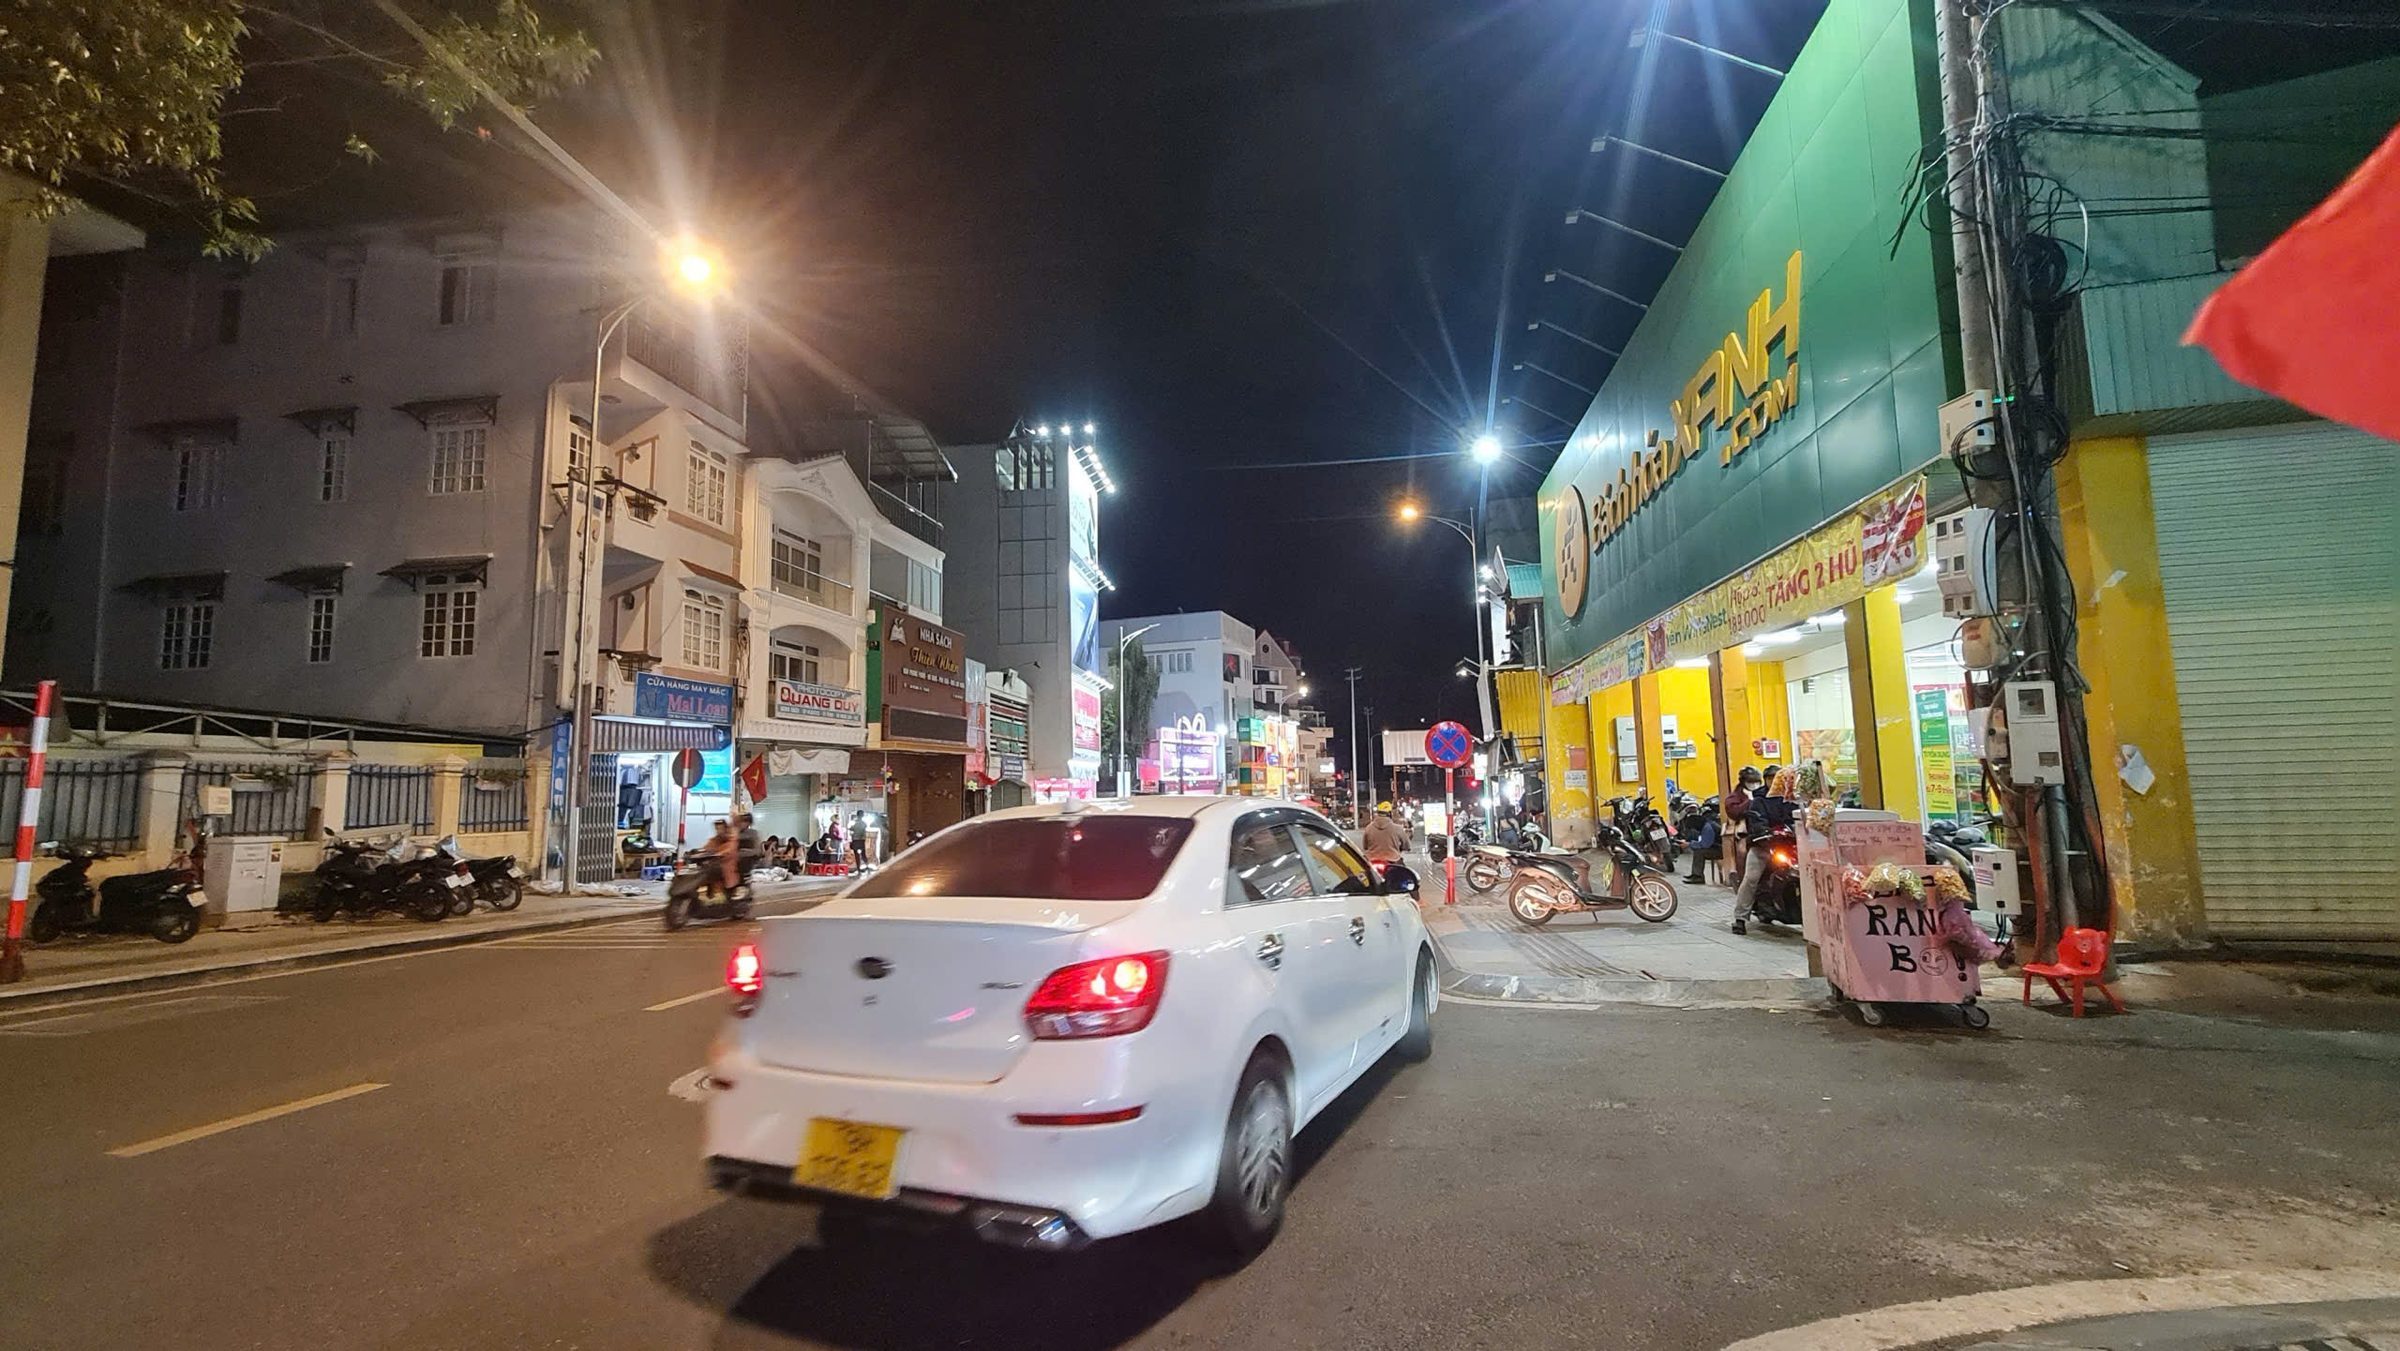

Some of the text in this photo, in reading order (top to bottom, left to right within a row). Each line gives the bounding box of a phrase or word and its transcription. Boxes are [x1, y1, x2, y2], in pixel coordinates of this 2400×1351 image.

[1814, 561, 1826, 590] 2
[691, 685, 708, 693] MAY
[797, 684, 847, 698] PHOTOCOPY
[780, 686, 831, 709] QUANG
[834, 699, 860, 713] DUY
